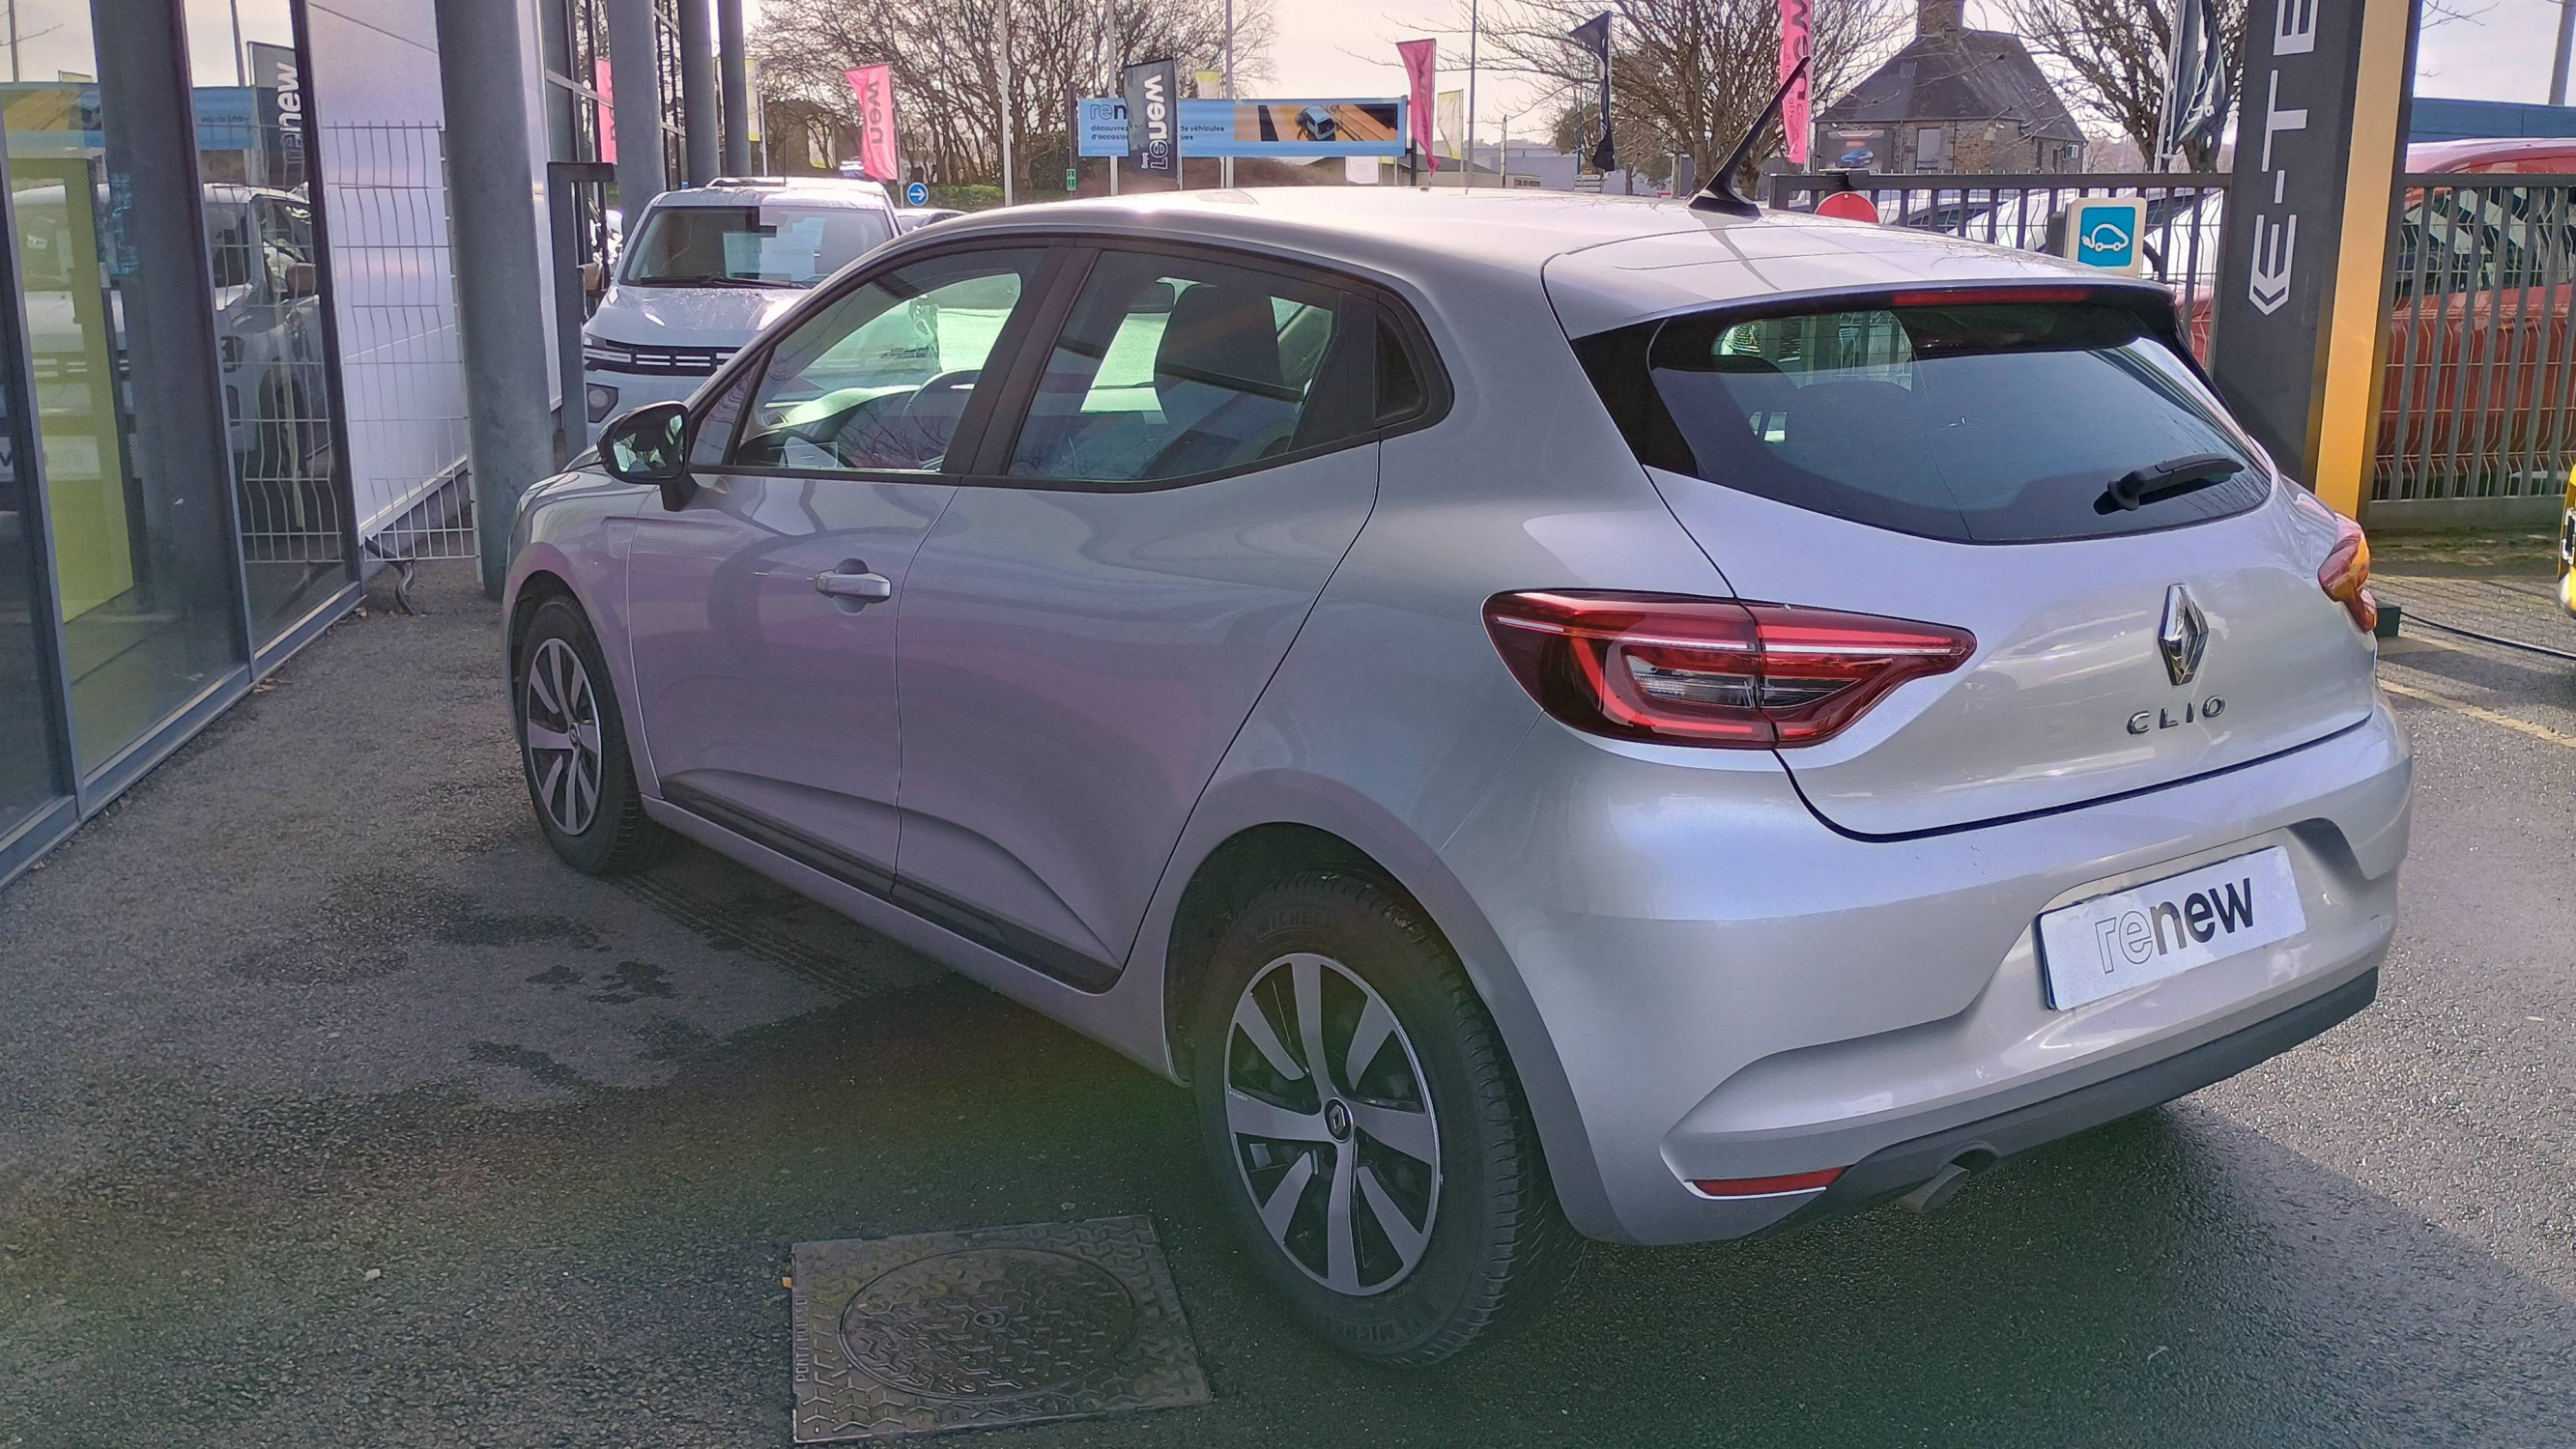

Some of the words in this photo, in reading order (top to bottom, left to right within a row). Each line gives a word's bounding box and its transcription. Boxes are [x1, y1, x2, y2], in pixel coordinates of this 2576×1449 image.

[1090, 103, 1128, 120] ren
[2127, 696, 2225, 735] CLIO
[2095, 877, 2254, 975] renew
